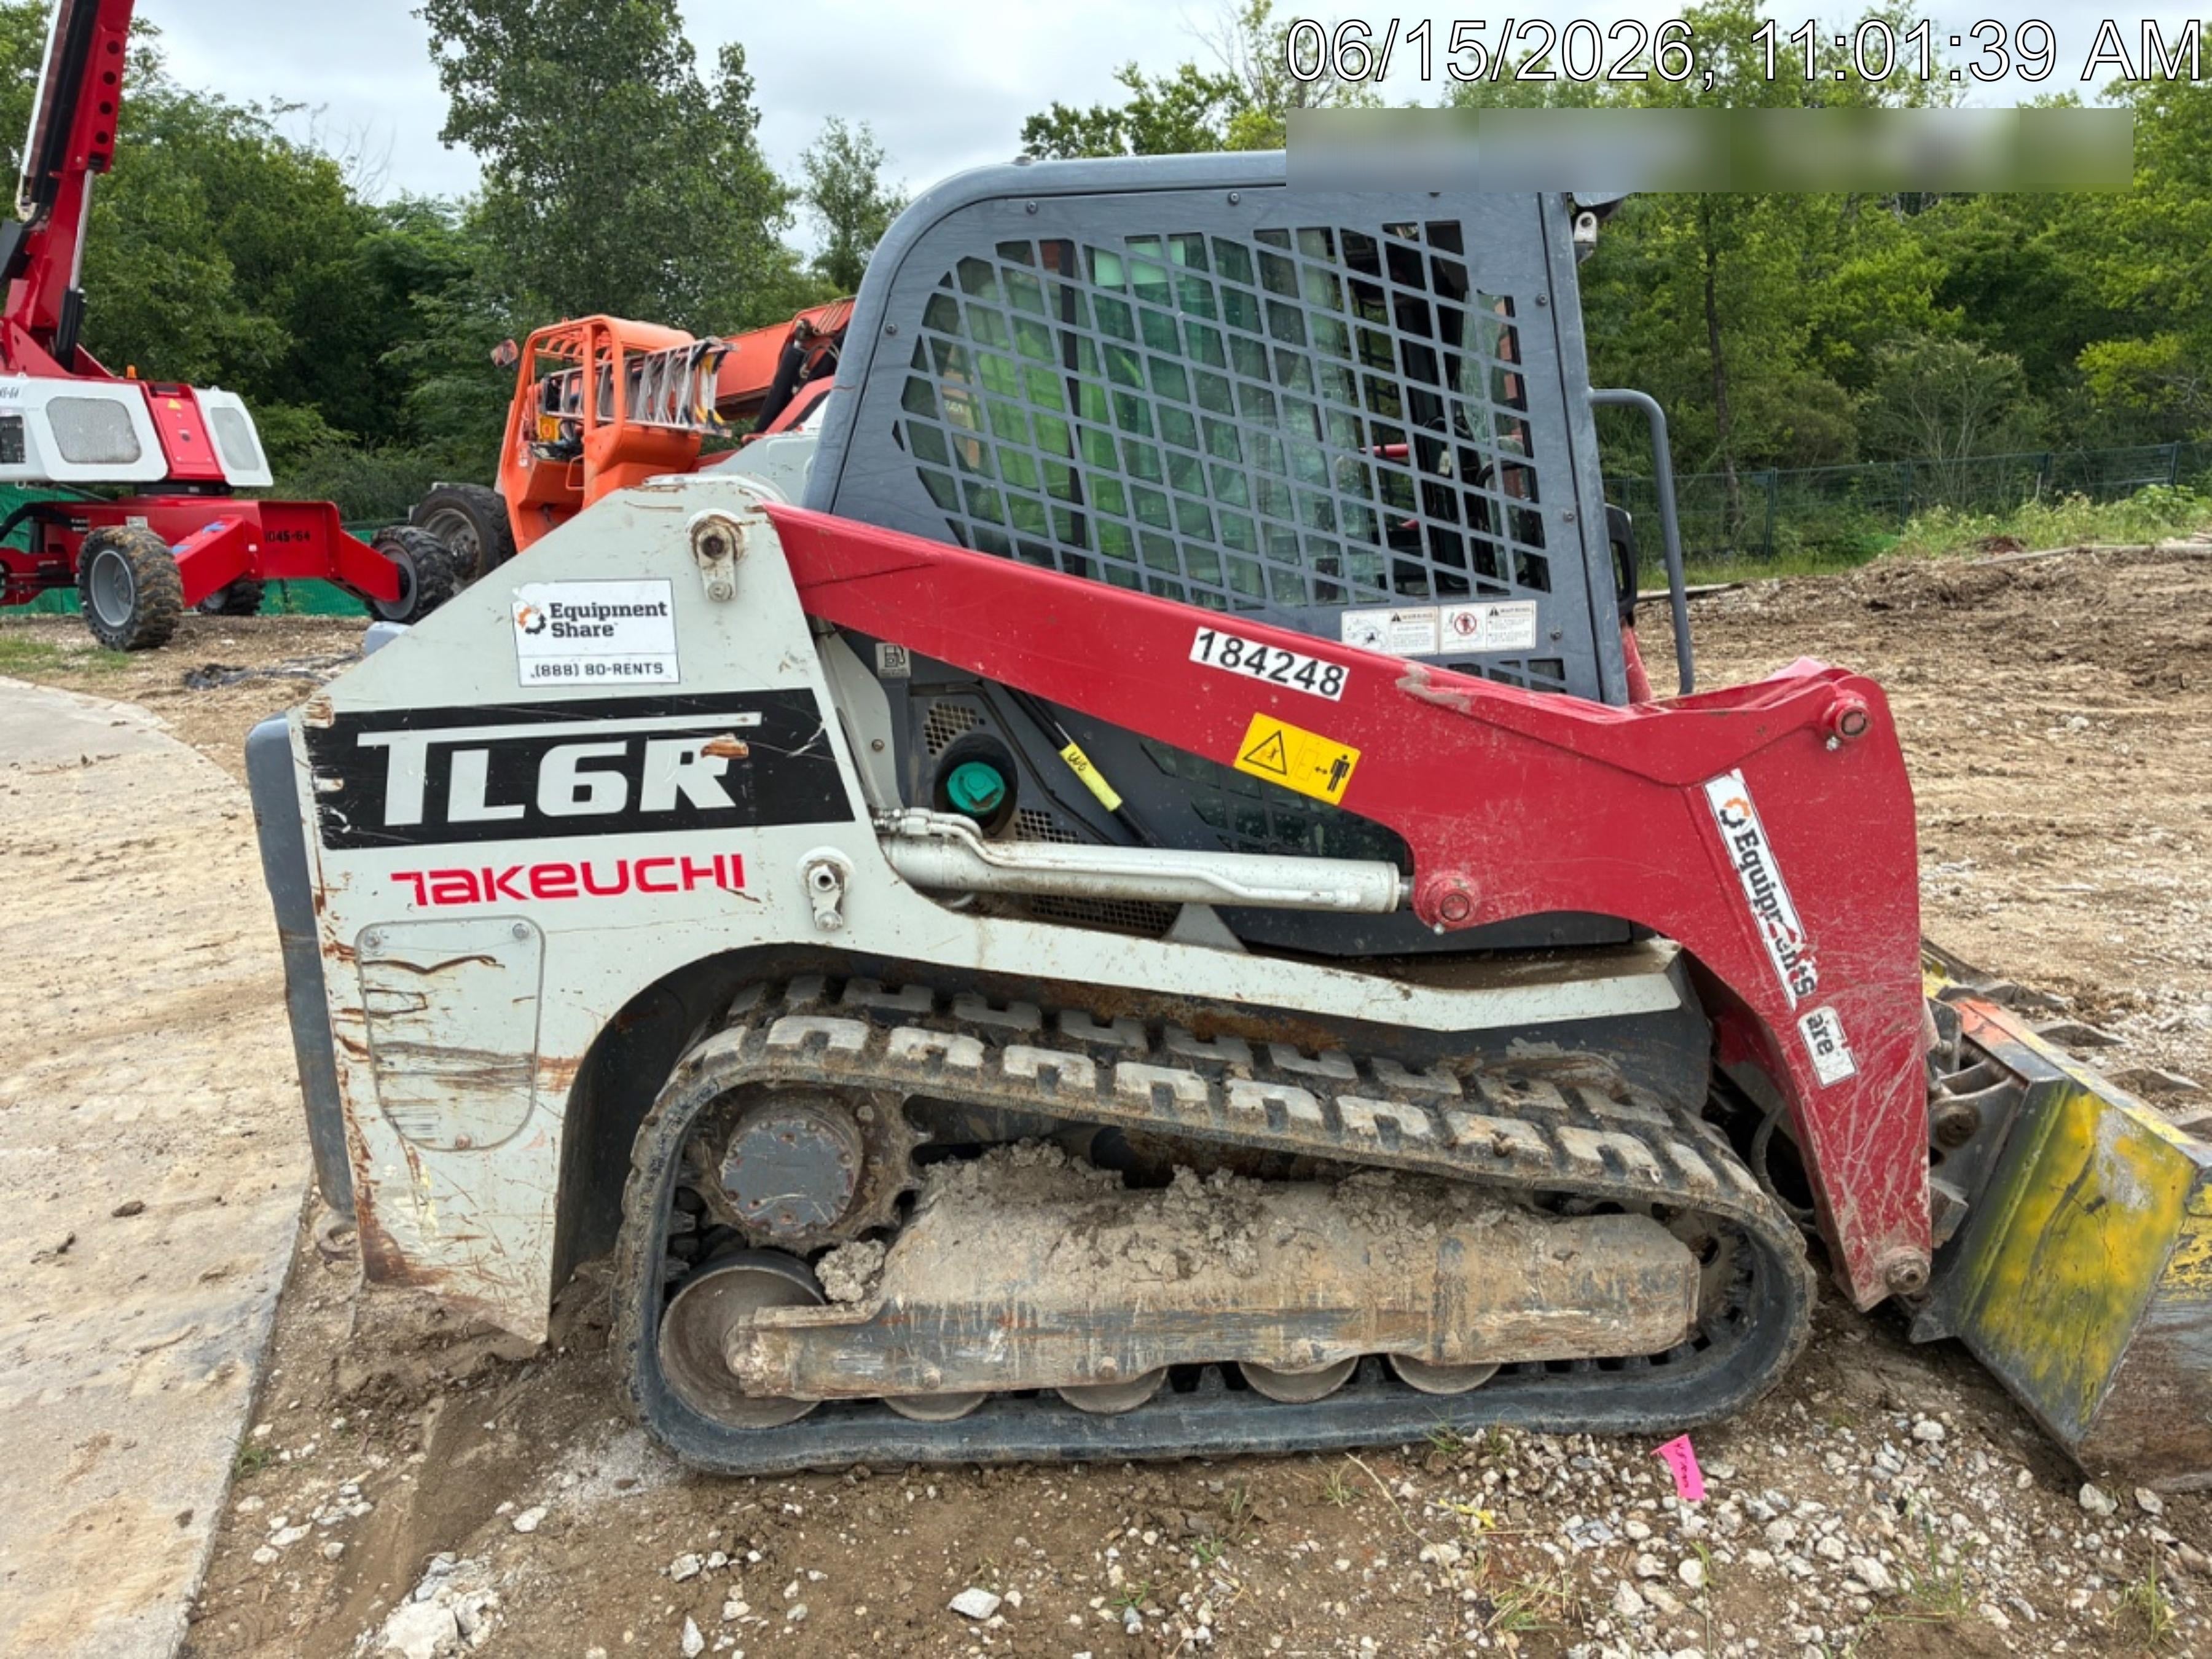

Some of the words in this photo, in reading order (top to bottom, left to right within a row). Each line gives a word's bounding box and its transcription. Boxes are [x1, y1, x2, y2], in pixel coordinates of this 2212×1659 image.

[549, 602, 668, 621] Equipment
[552, 622, 615, 638] Share
[535, 664, 579, 677] (888)
[585, 662, 664, 676] 80-RENTS
[1198, 631, 1344, 696] 184248
[357, 712, 762, 826] TL6R
